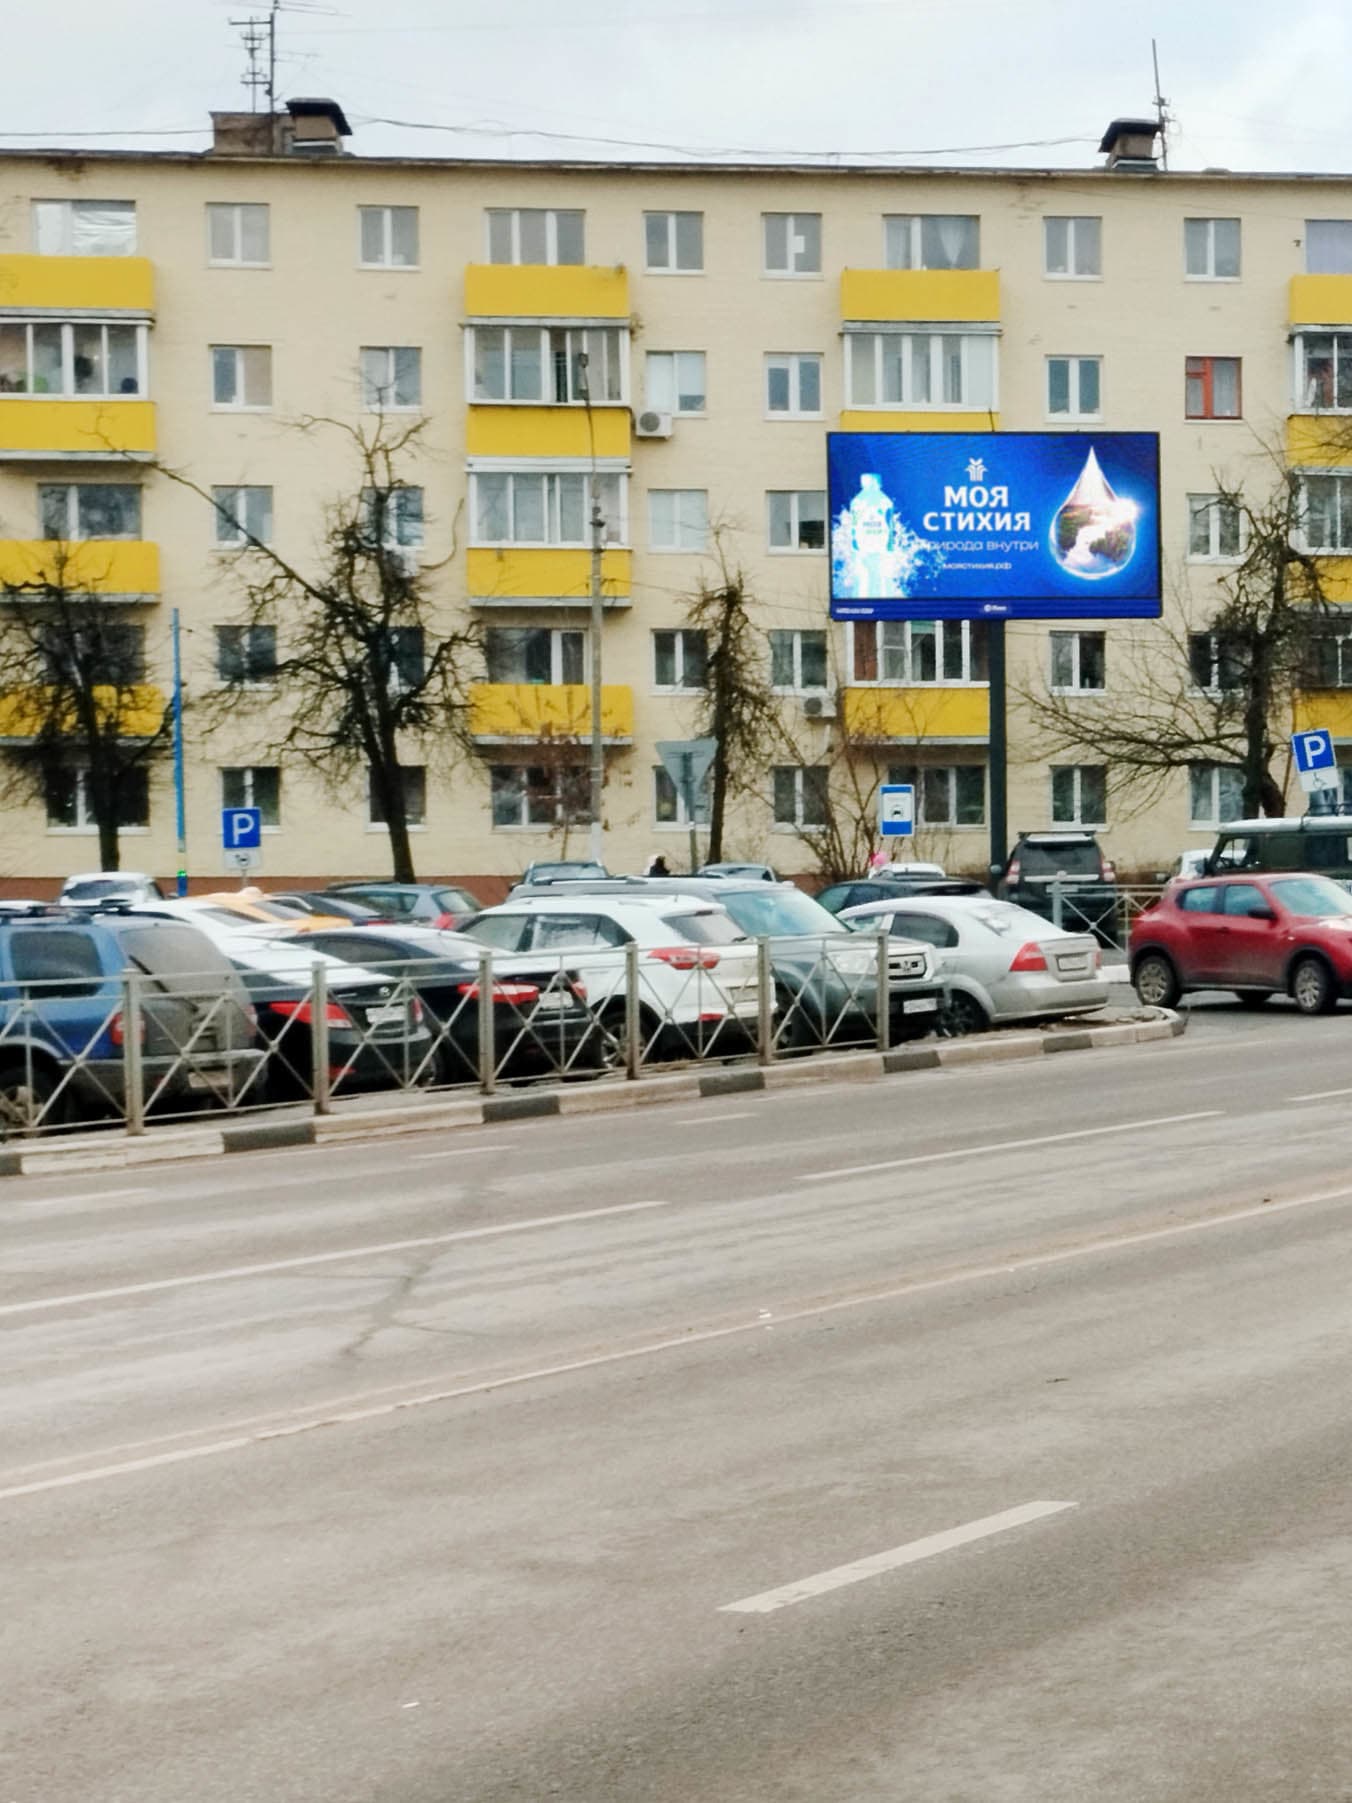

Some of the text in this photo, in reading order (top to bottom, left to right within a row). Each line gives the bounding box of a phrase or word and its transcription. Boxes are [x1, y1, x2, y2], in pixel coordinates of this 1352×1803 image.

[944, 485, 1008, 508] МОЯ
[922, 511, 1031, 532] СТИХИЯ
[918, 541, 1040, 552] рирода внутри
[1303, 735, 1327, 768] P
[232, 813, 255, 846] P
